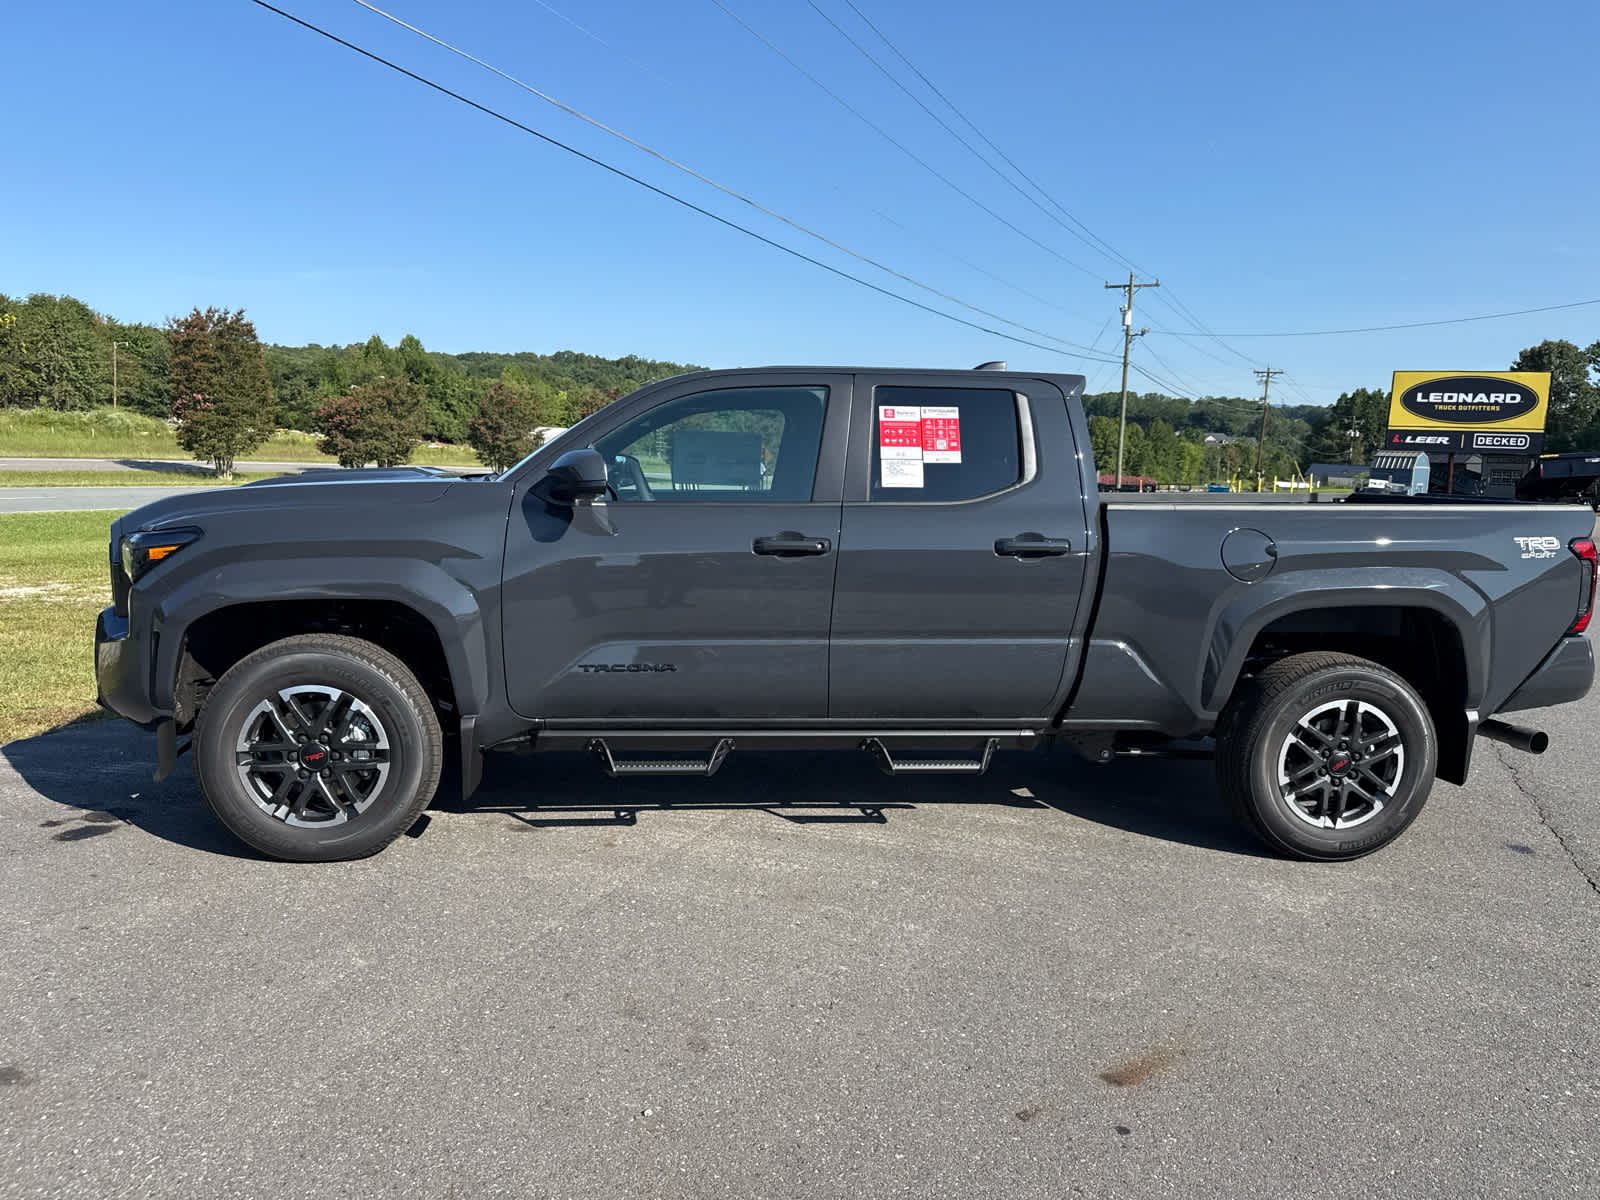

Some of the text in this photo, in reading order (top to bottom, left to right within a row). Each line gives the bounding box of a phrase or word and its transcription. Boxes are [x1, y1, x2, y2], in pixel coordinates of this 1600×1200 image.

[1416, 392, 1521, 403] LEONARD
[1404, 435, 1450, 445] LEER
[1477, 437, 1526, 446] DECKED
[1513, 536, 1560, 551] TRD
[1521, 551, 1556, 559] SPORT
[577, 663, 677, 673] TACOMA
